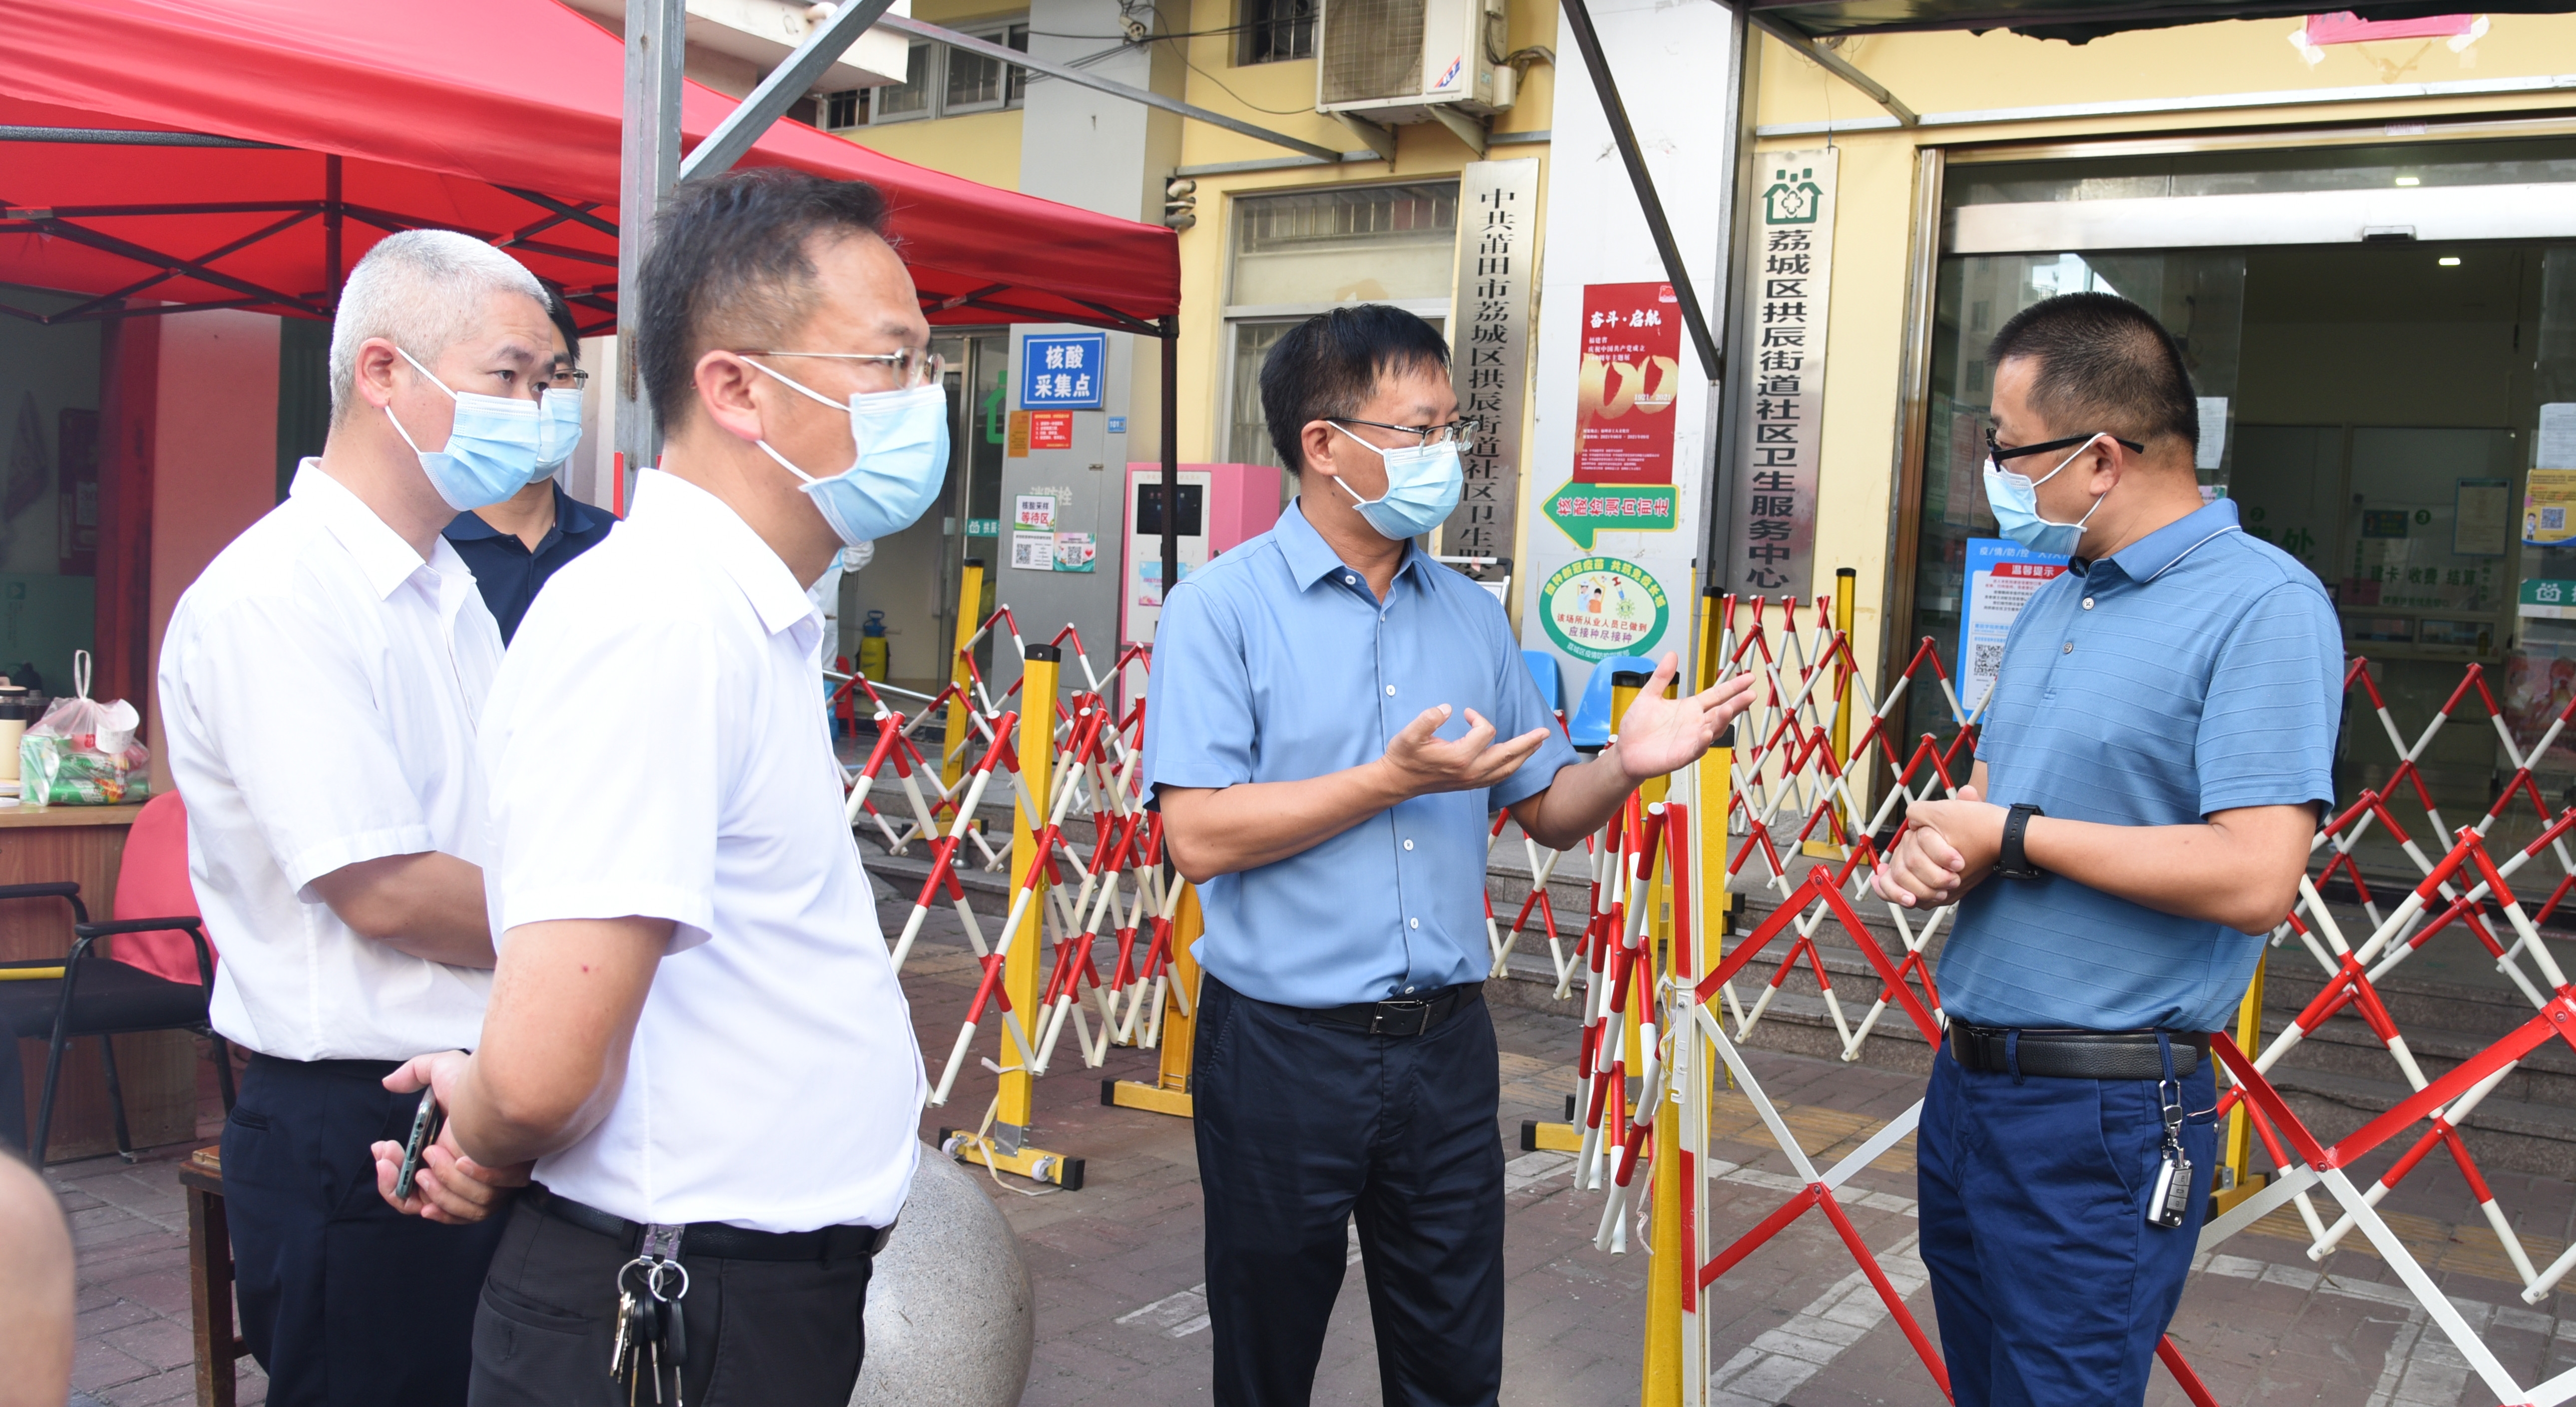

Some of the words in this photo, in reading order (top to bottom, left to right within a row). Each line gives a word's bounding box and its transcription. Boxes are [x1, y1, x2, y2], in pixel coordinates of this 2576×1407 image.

[1590, 309, 1662, 329] 奋斗·启航
[1046, 344, 1084, 370] 核酸
[1588, 345, 1646, 353] 庆祝中国共产党成立
[1034, 373, 1091, 399] 采集点
[1746, 229, 1813, 589] 荔城区拱辰街道社区卫生服务中心
[1022, 501, 1049, 510] 核酸采样
[1556, 496, 1669, 517] 核酸检测向前走
[983, 521, 1001, 533] 拱辰
[1021, 511, 1049, 524] 等待区
[2011, 564, 2055, 577] 温馨提示
[1544, 558, 1605, 596] 接种新冠疫苗
[1610, 560, 1667, 608] 共筑免疫长城
[1557, 613, 1647, 633] 该场所从业人员已做到
[1568, 626, 1633, 644] 应接种尽接种
